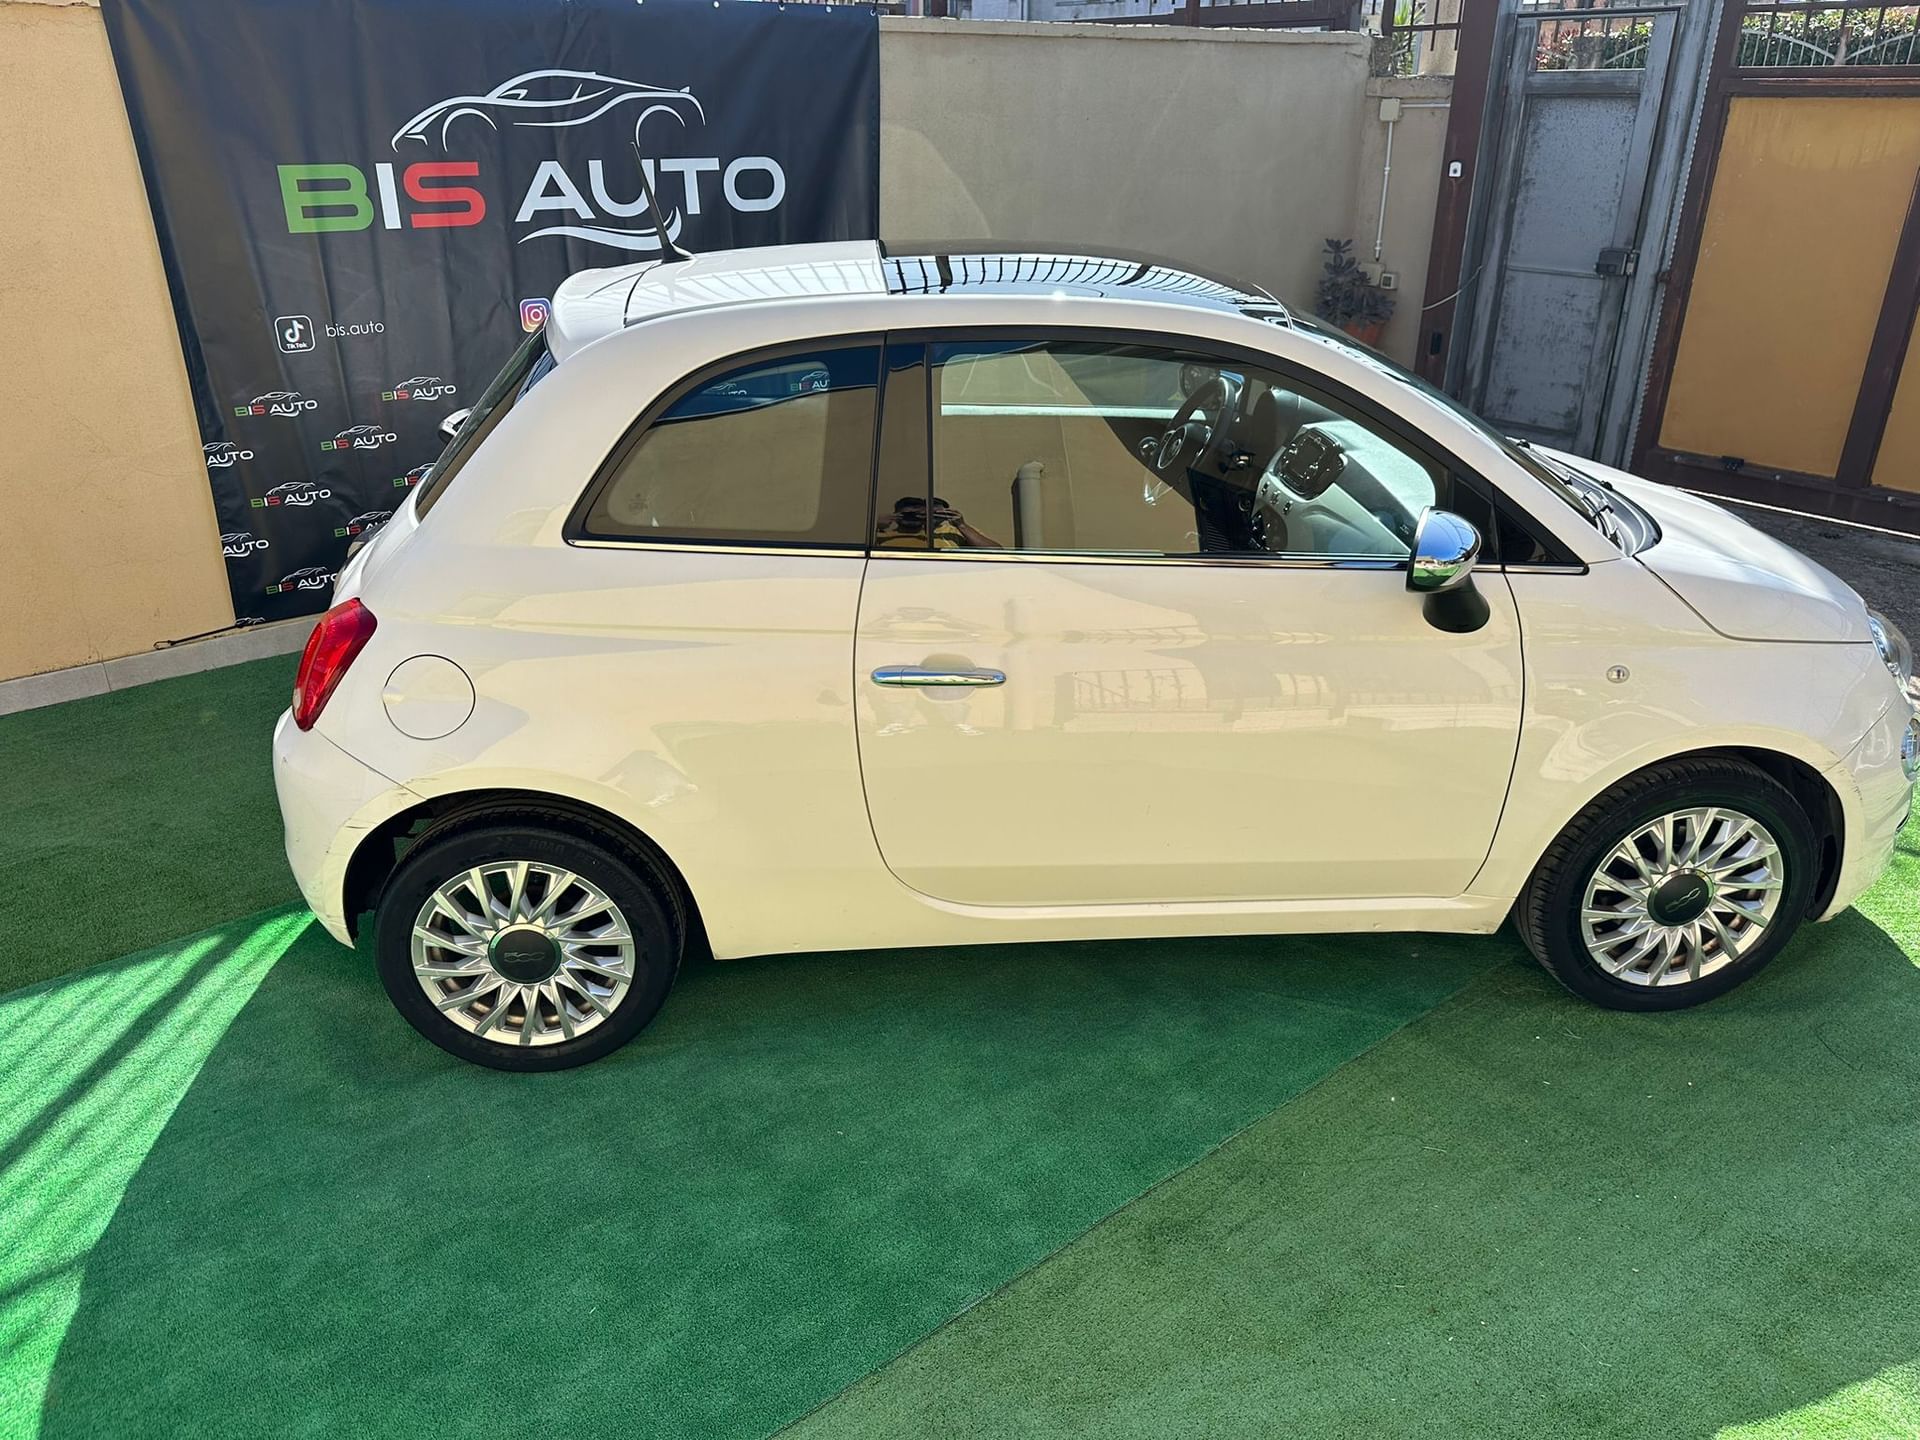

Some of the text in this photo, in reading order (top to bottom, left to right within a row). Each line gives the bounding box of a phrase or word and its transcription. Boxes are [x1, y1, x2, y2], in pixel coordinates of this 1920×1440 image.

[276, 156, 786, 233] BIS AUTO
[325, 320, 385, 338] bis.auto
[381, 385, 457, 401] BIS AUTO
[234, 400, 318, 417] BIS AUTO
[320, 433, 398, 451] BIS AUTO
[206, 450, 254, 466] AUTO
[393, 475, 419, 488] BIS
[250, 489, 331, 508] BIS AUTO
[334, 524, 361, 538] BIS
[222, 539, 269, 555] AUTO
[265, 582, 294, 595] BIS
